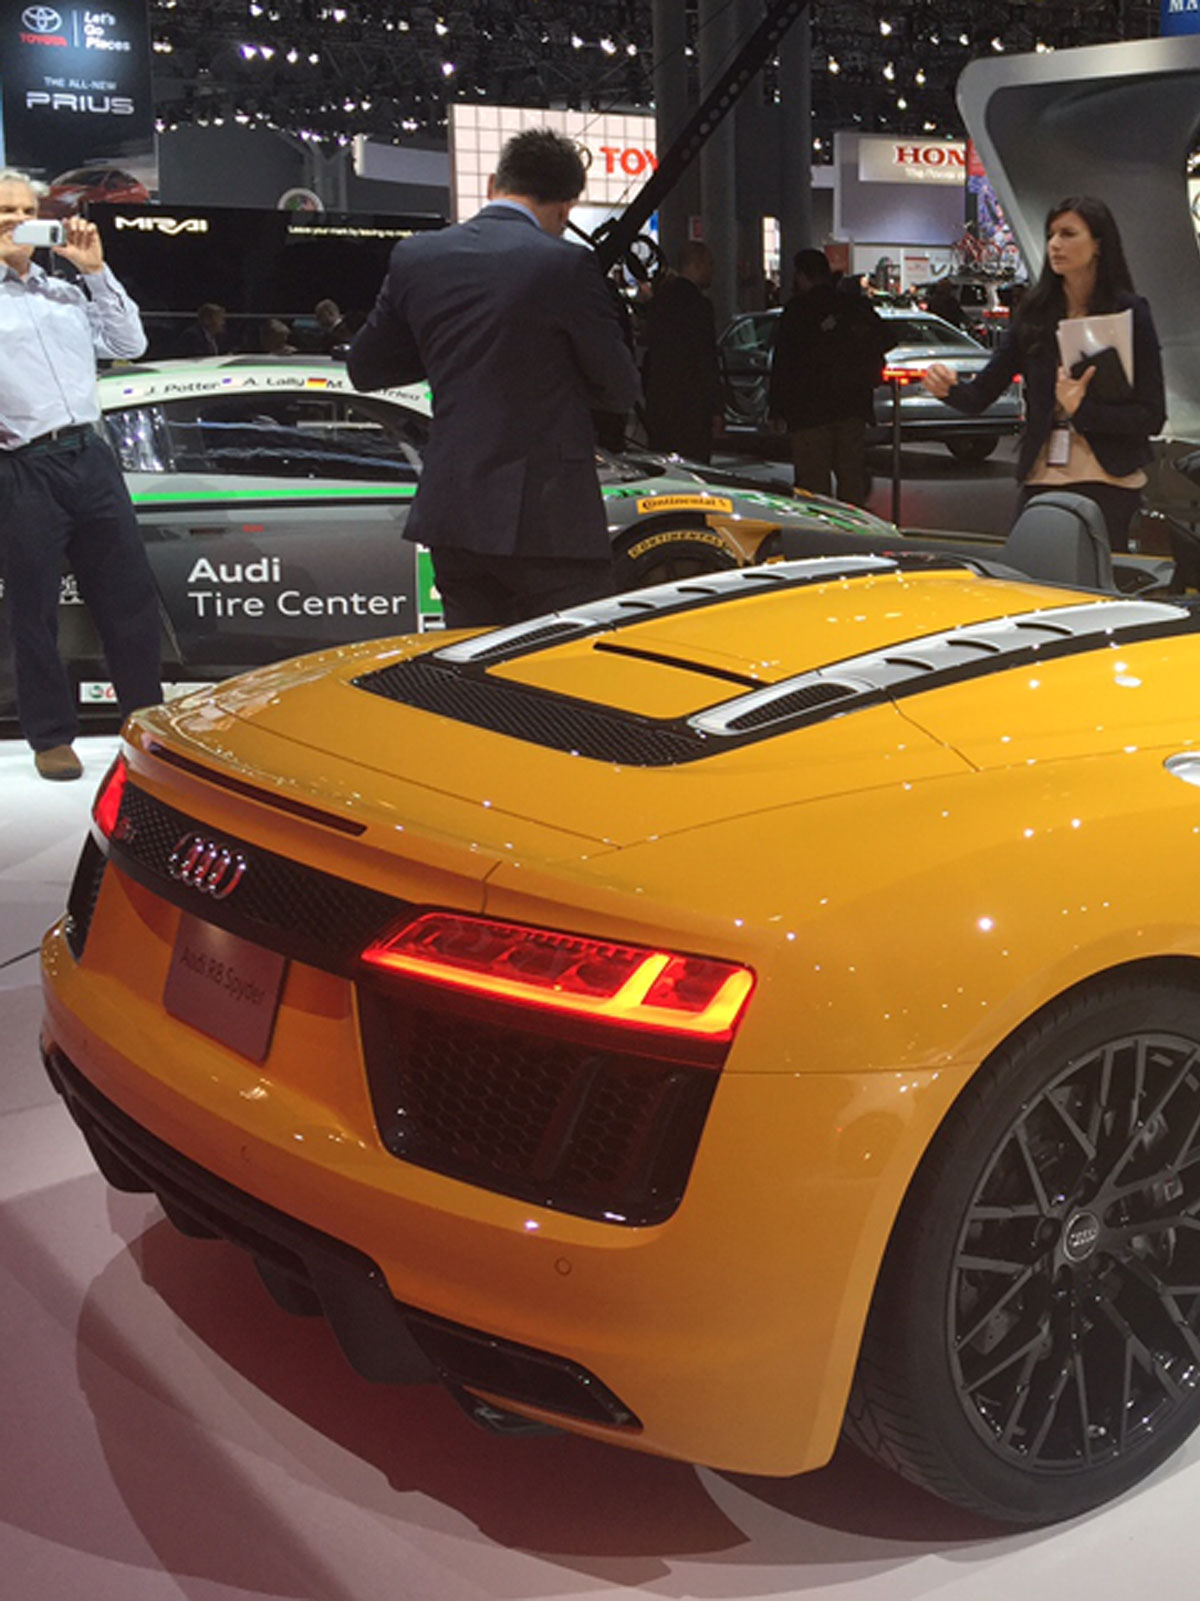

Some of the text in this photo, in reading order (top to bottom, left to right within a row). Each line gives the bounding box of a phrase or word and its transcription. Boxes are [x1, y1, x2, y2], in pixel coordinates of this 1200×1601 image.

[84, 24, 104, 36] Go
[86, 36, 131, 51] Places
[44, 76, 65, 88] THE
[26, 91, 135, 115] PRIUS
[115, 216, 208, 235] MIRAI
[165, 381, 221, 393] Potter
[188, 557, 280, 583] Audi
[187, 590, 407, 617] Tire Center
[180, 946, 206, 976] Audi
